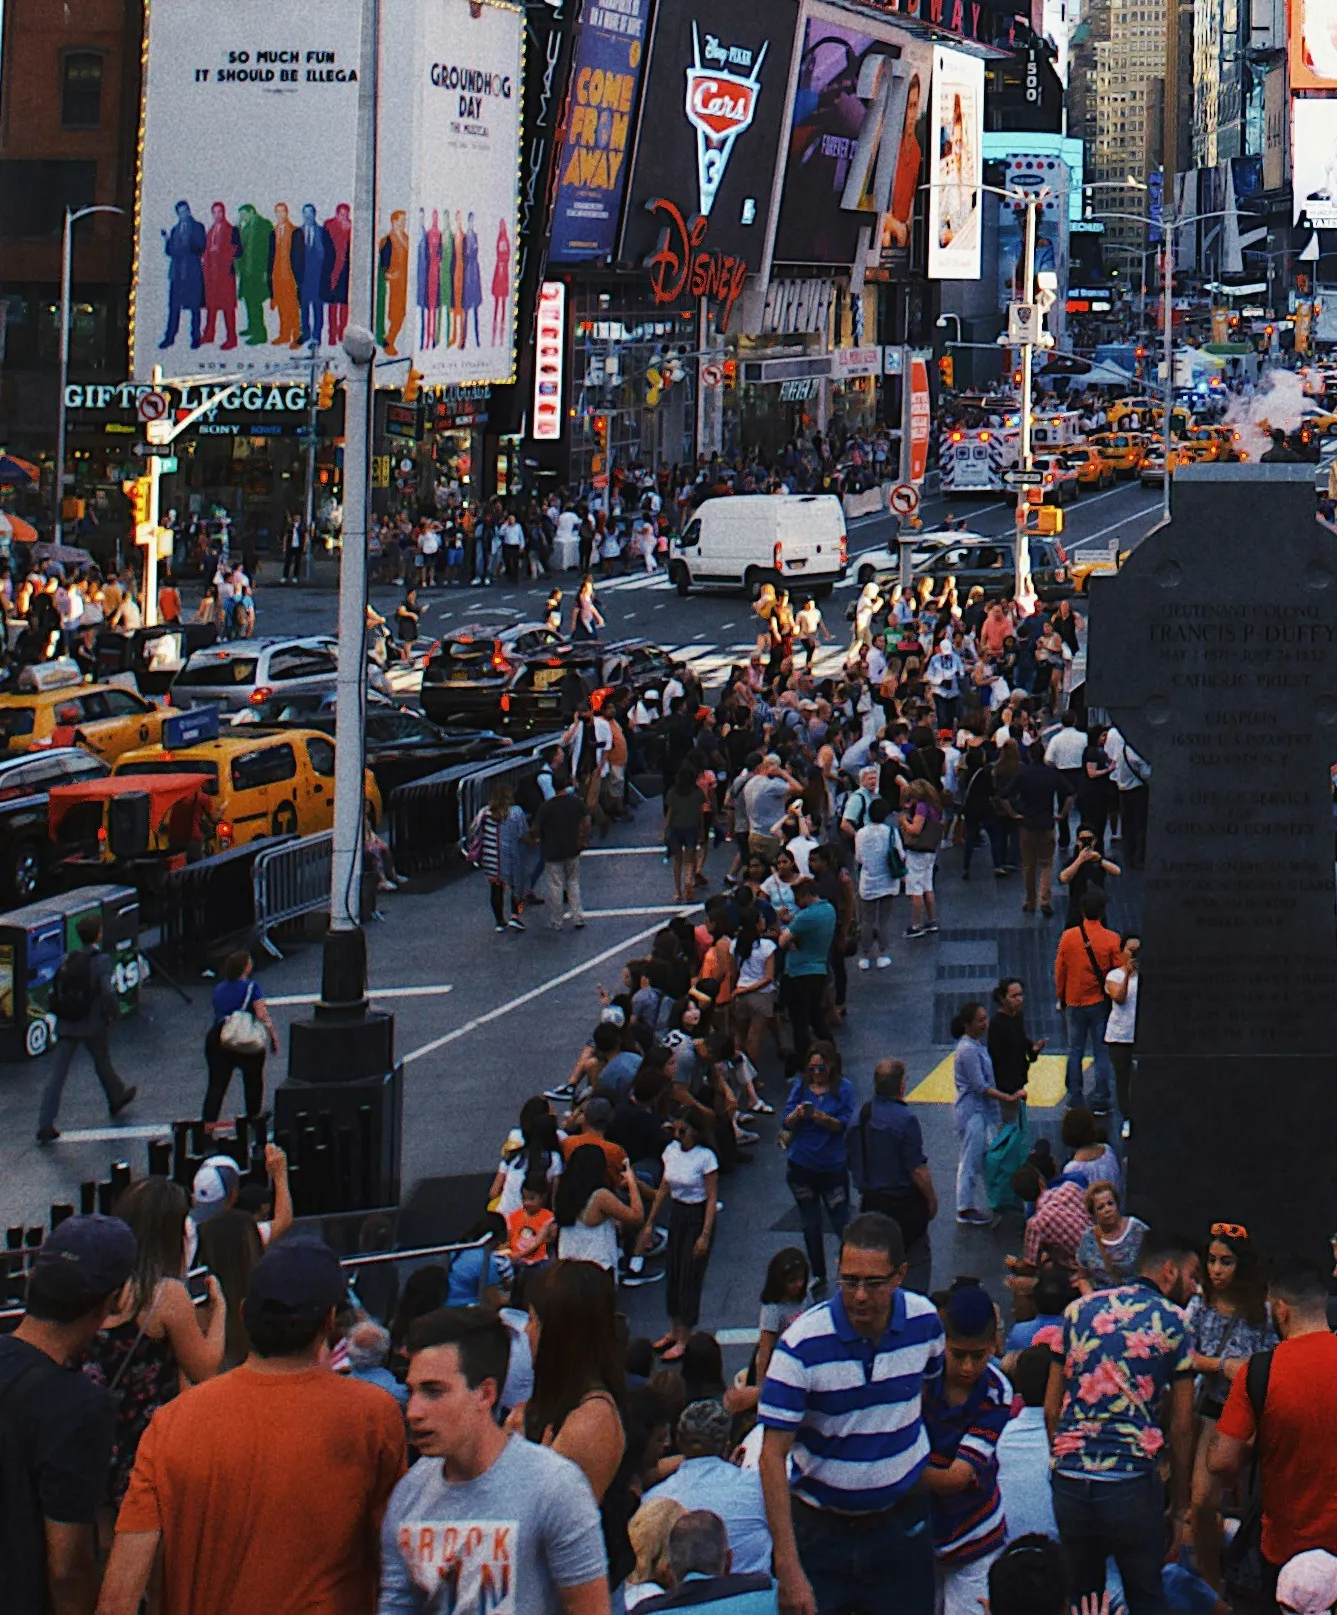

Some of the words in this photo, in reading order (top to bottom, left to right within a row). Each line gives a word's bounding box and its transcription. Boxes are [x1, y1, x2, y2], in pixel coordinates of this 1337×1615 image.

[228, 51, 250, 64] SO
[256, 51, 300, 64] MUCH
[306, 51, 335, 64] FUN
[195, 69, 209, 82] IT
[217, 69, 275, 82] SHOULD
[280, 69, 299, 82] BE
[306, 69, 358, 82] ILLEGA
[431, 63, 511, 99] GROUNDHOG
[1026, 49, 1037, 102] 1500
[577, 67, 635, 113] COME
[693, 81, 746, 121] Cars
[459, 95, 483, 120] DAY
[562, 147, 624, 190] AWAY
[179, 385, 312, 411] LUGGAG
[199, 424, 240, 435] SONY
[1148, 623, 1236, 643] FRANCIS
[1265, 623, 1337, 643] DUFFY
[1257, 673, 1312, 688] PRIEST
